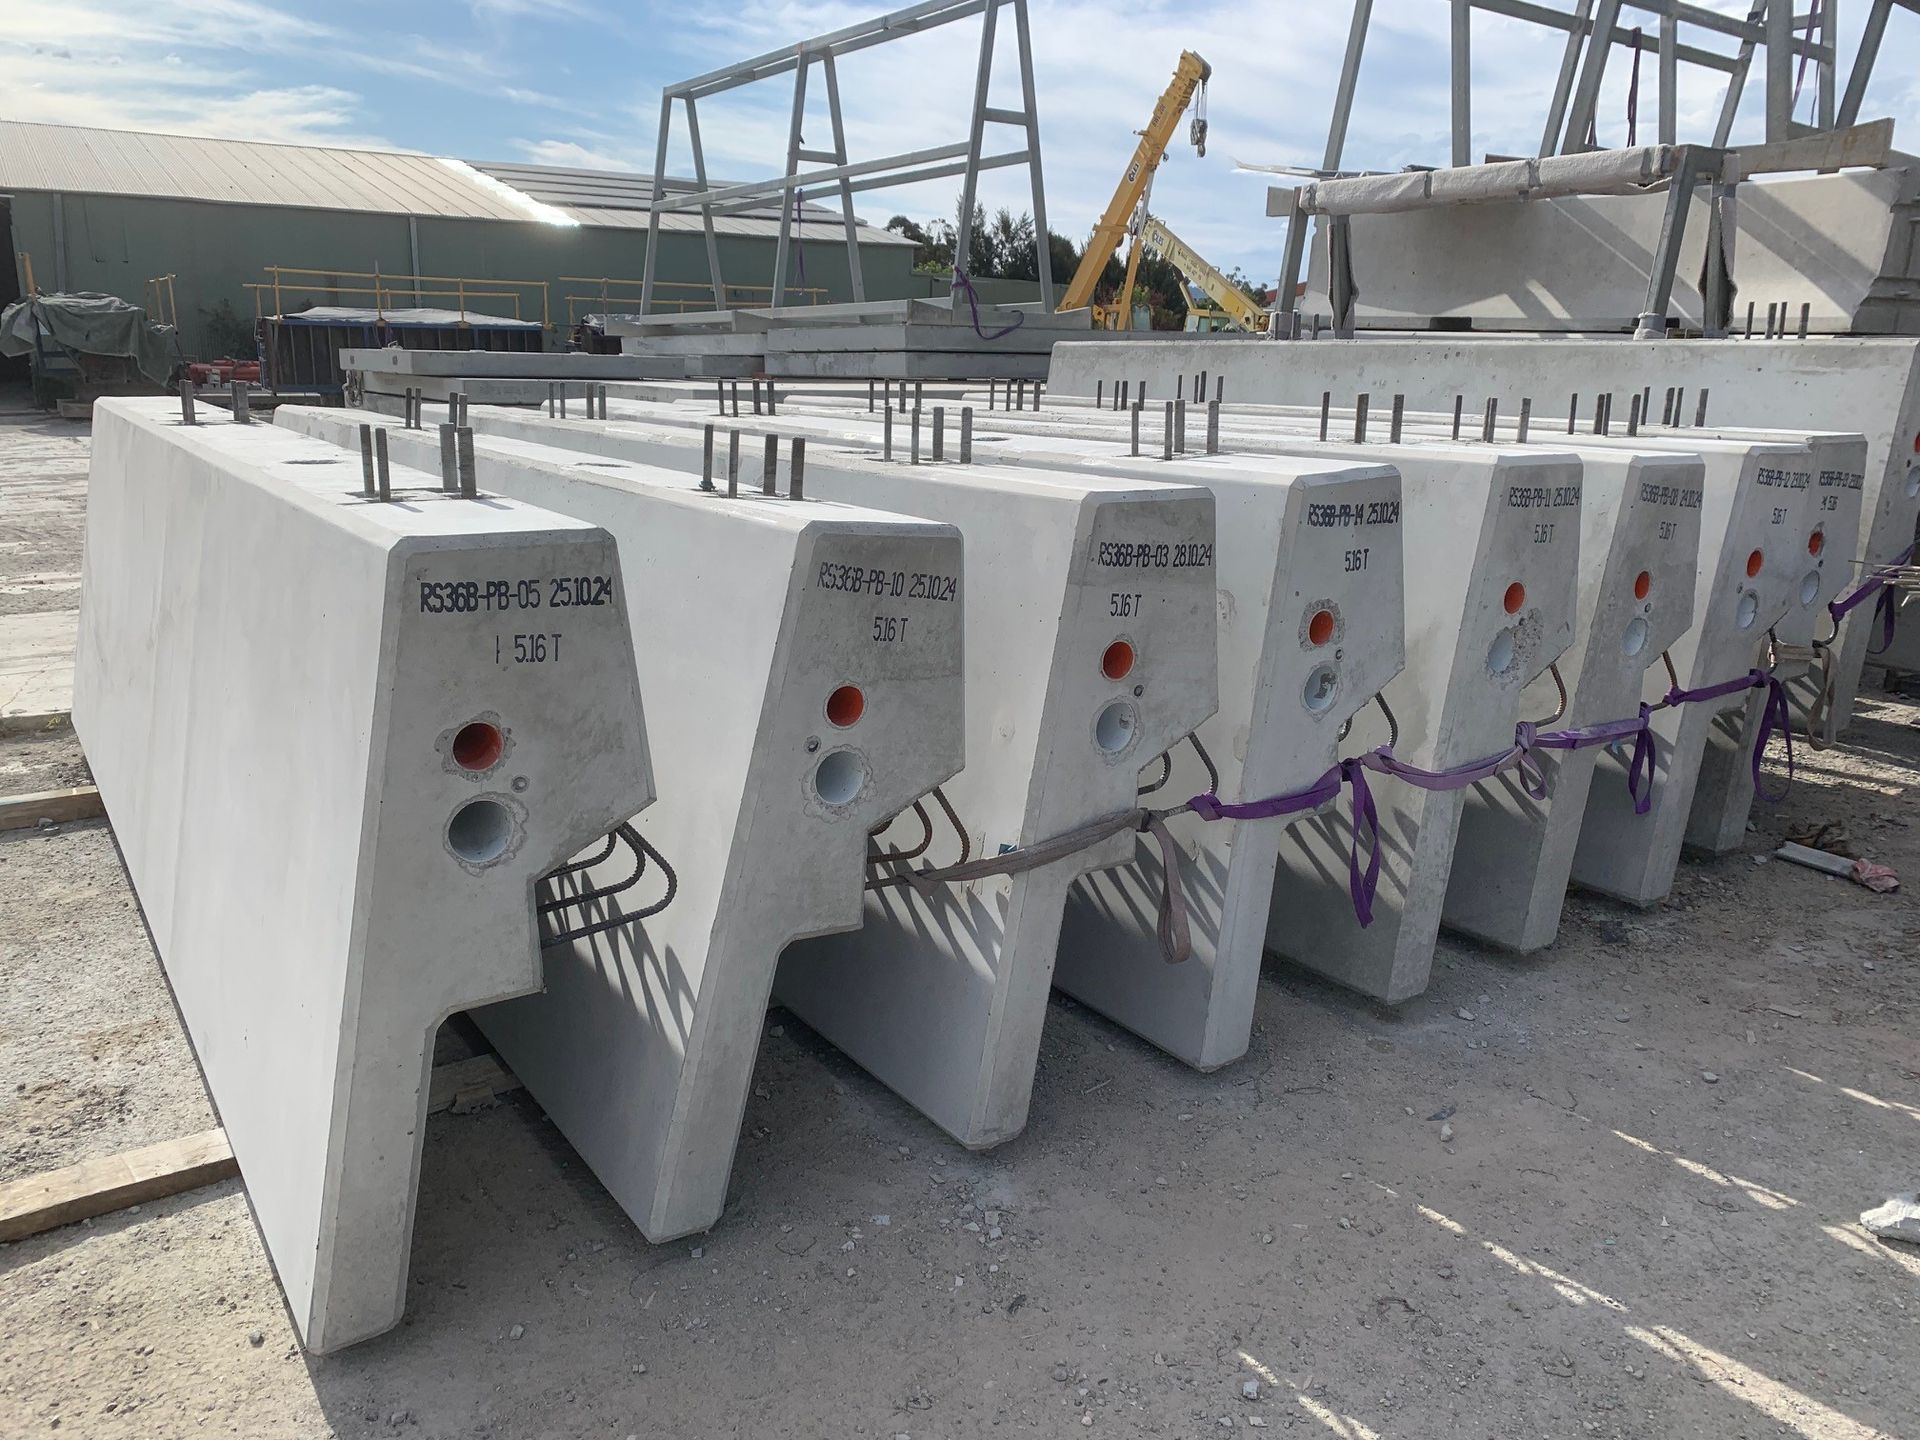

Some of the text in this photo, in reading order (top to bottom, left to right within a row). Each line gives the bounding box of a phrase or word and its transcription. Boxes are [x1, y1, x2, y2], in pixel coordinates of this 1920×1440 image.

[1508, 486, 1552, 508] RS36B-PB-11
[1307, 503, 1364, 527] RS36B-PB-14
[1098, 542, 1213, 567] RS36B-PB-03 28.10.24
[1363, 548, 1370, 570] T
[817, 561, 957, 602] RS36B-PB-10 25.10.24
[420, 580, 541, 613] RS36B-PB-05
[1134, 594, 1142, 617] T
[900, 617, 909, 642] T
[514, 633, 547, 663] 5.16
[551, 633, 562, 662] T
